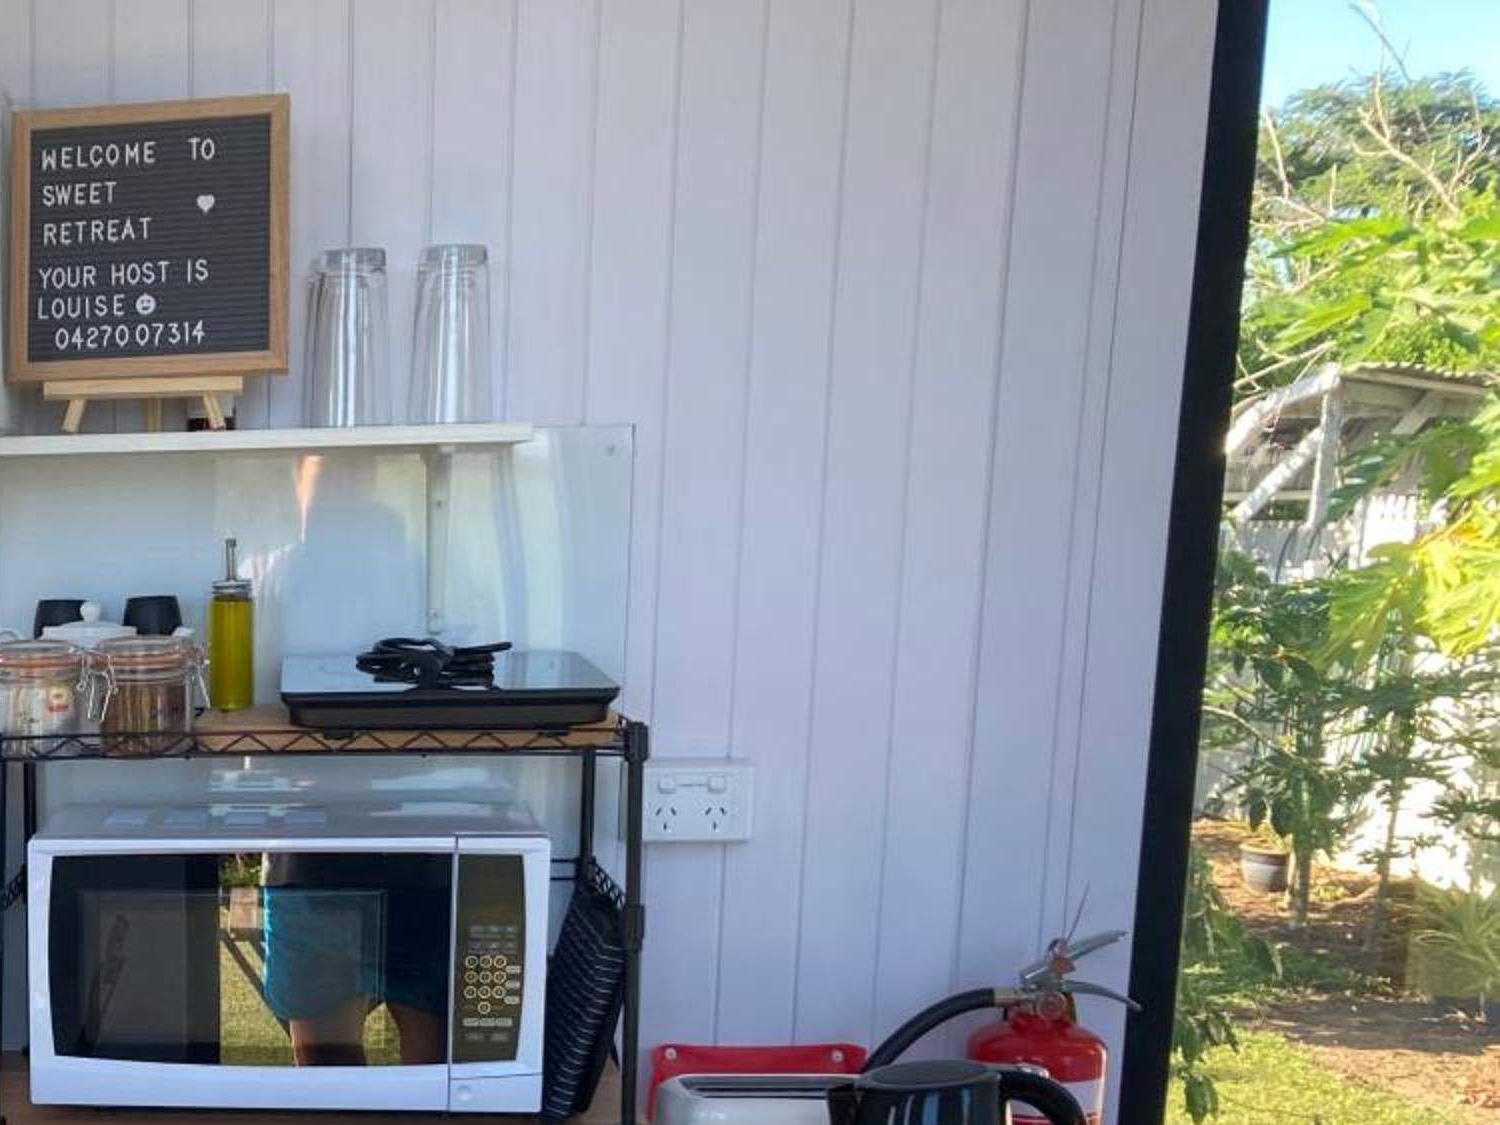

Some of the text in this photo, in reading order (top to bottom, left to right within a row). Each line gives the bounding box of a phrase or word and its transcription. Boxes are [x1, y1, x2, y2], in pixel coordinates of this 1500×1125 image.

[42, 137, 215, 170] WELCOME TO
[43, 181, 117, 207] SWEET
[43, 217, 152, 245] RETREAT
[38, 259, 209, 290] YOUR HOST IS
[37, 293, 126, 320] LOUISE
